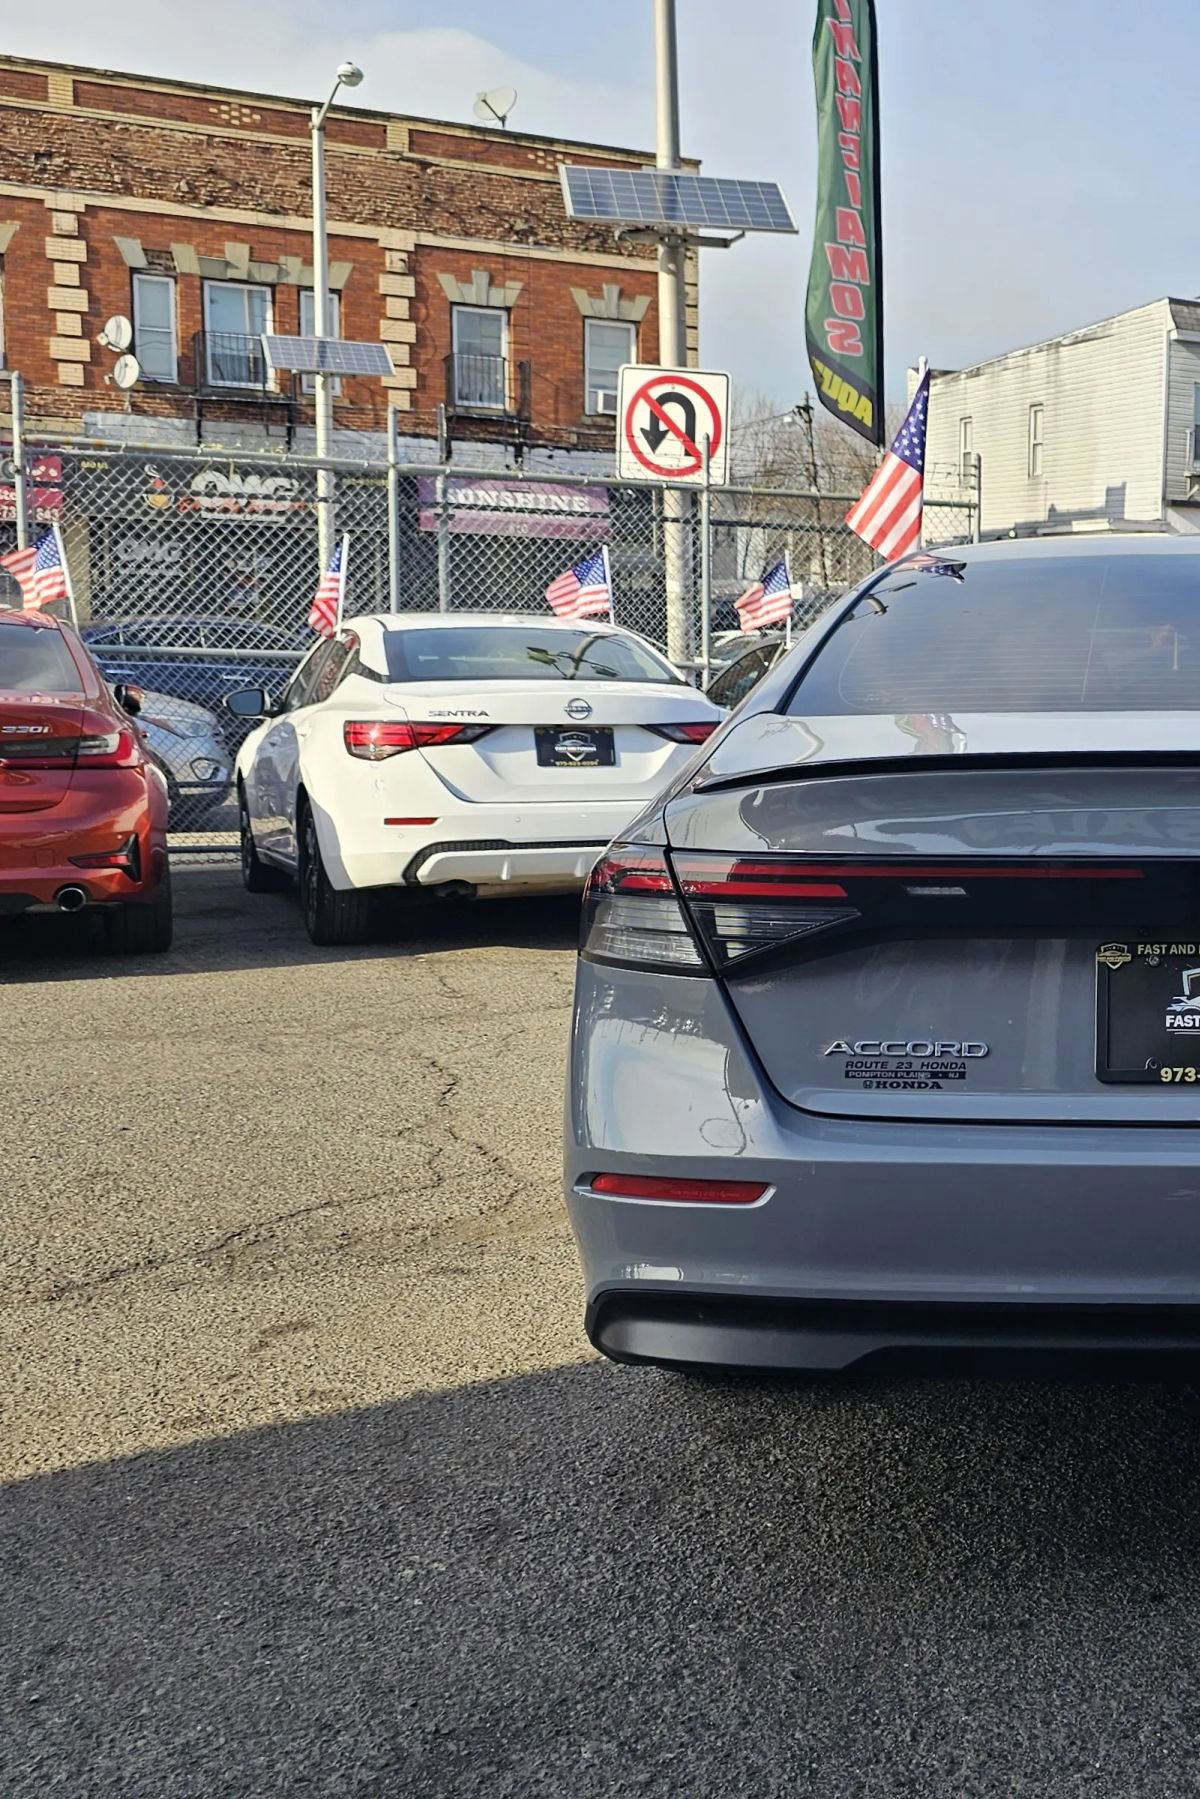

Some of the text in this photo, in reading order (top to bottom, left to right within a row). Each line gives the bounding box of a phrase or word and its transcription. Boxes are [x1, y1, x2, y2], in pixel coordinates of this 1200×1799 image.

[1137, 944, 1168, 955] FAST
[1169, 944, 1195, 955] AND
[824, 1040, 989, 1058] ACCORD
[845, 1061, 967, 1071] ROUTE 23 HONDA
[897, 1071, 931, 1079] PLAINS
[875, 1080, 943, 1090] HONDA
